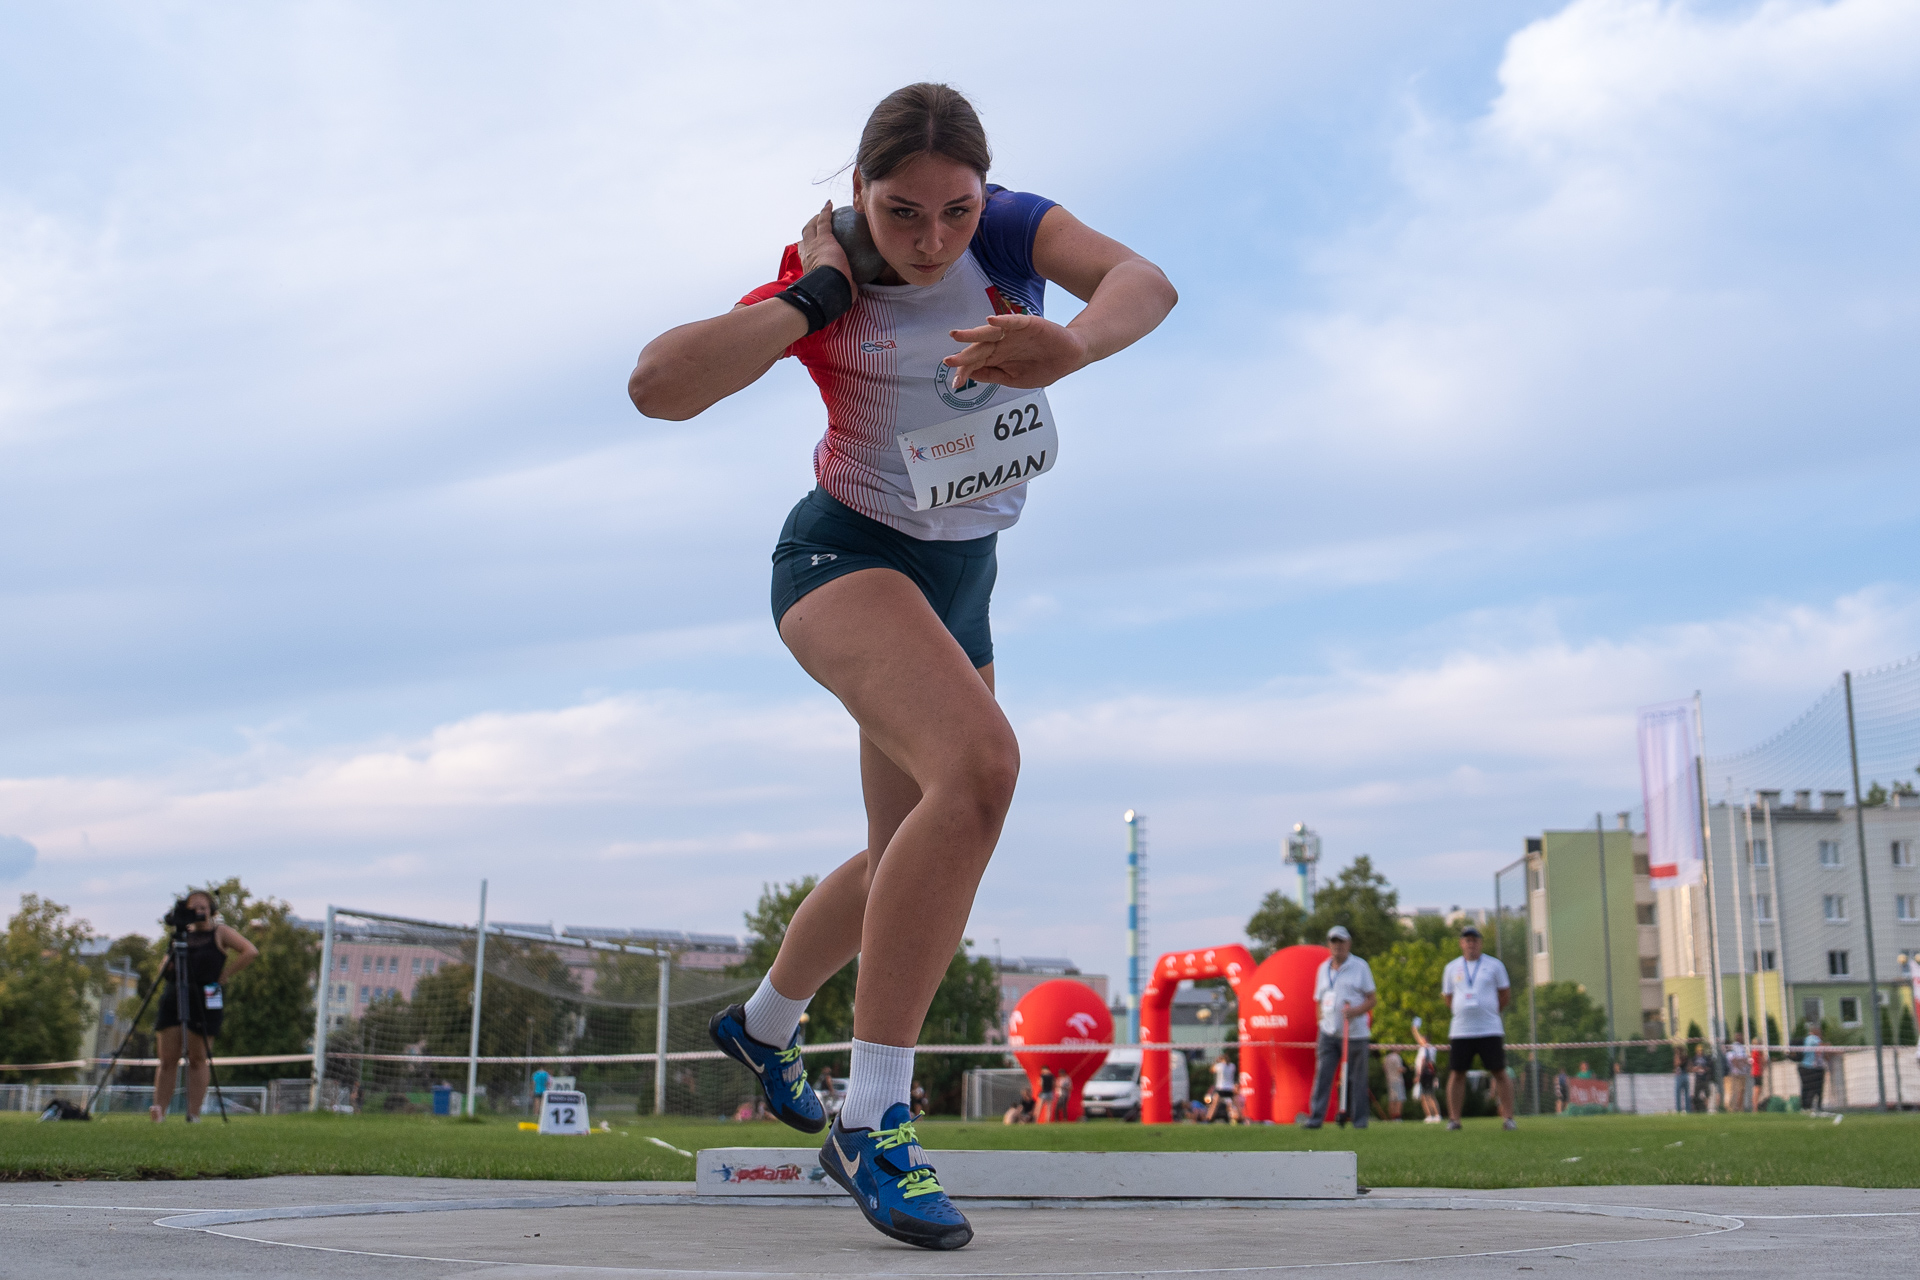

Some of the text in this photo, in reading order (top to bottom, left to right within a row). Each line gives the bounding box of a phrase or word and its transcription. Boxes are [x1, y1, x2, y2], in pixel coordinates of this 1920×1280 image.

[861, 339, 897, 353] esa
[937, 363, 948, 383] LSY
[994, 403, 1043, 441] 622
[931, 433, 975, 458] mosir
[929, 450, 1046, 509] LIGMAN
[1251, 1015, 1288, 1028] ORLEN
[551, 1107, 576, 1124] 12
[907, 1145, 930, 1168] NI
